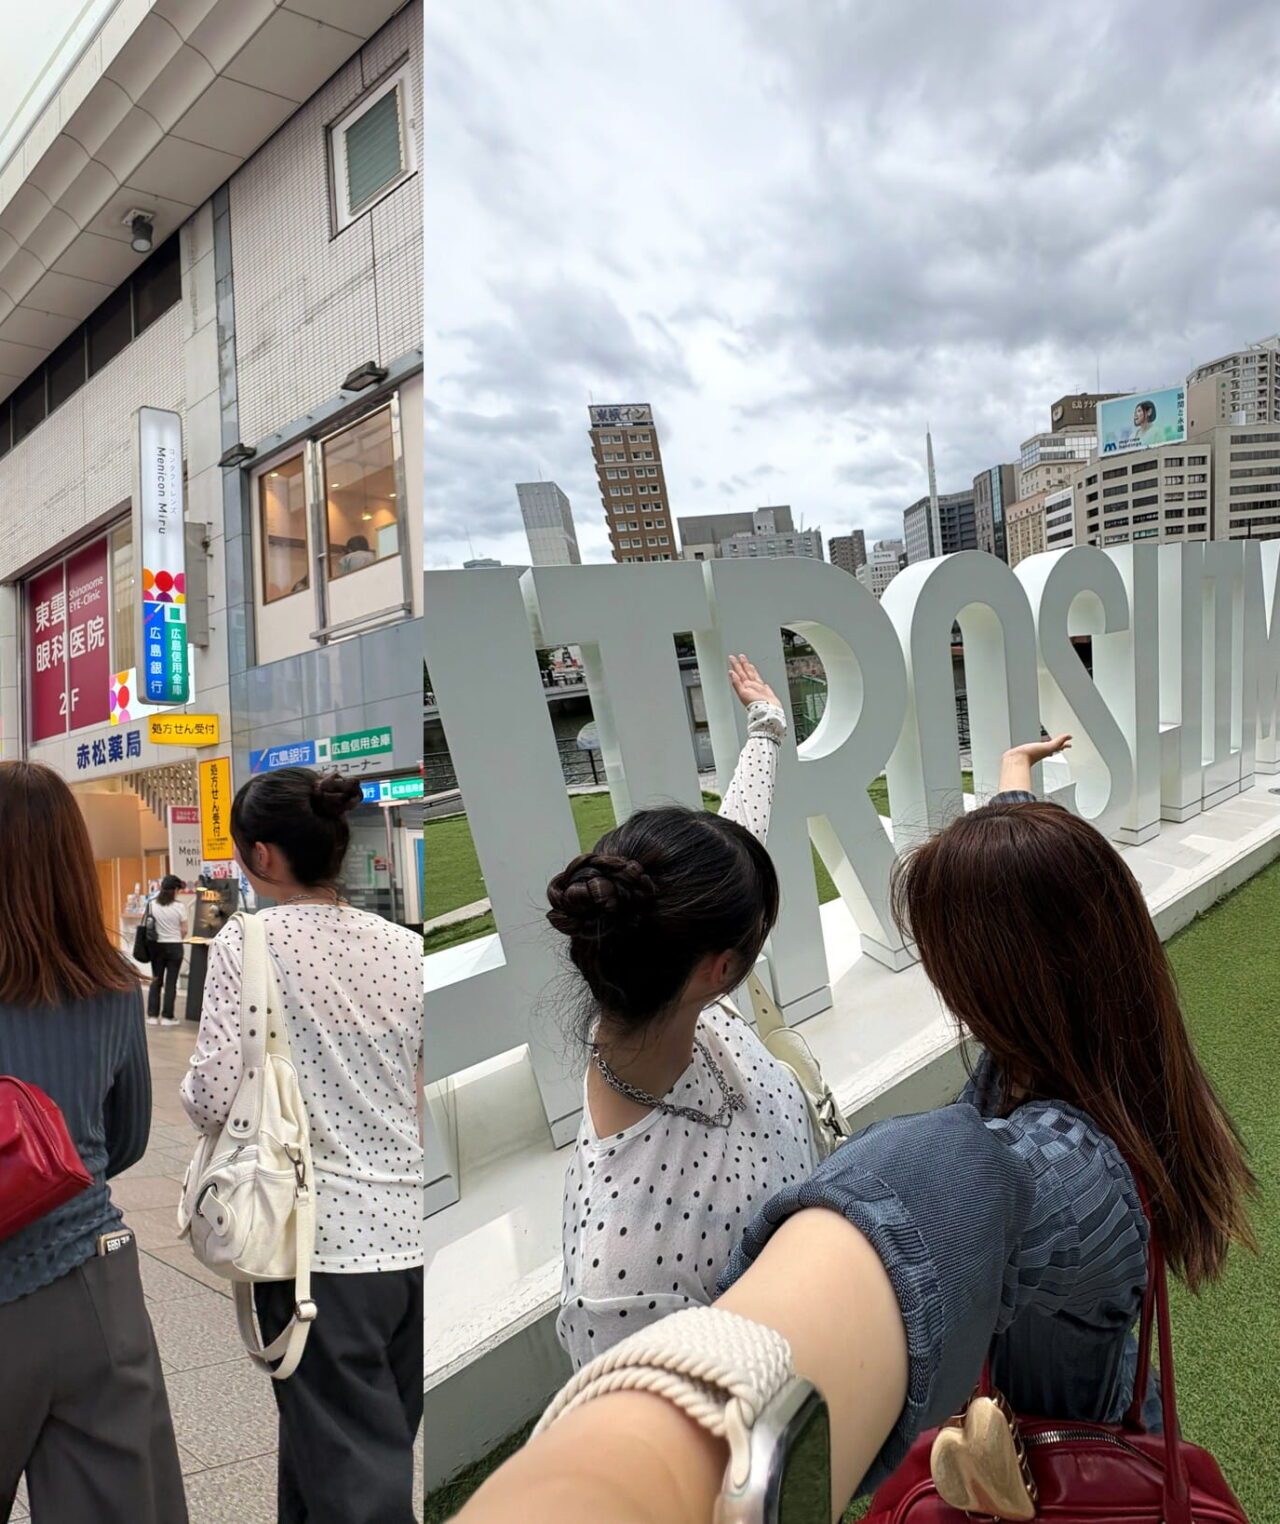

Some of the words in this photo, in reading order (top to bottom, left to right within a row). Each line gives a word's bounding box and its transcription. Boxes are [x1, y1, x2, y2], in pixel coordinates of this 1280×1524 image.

[596, 407, 646, 421] 東横イン
[156, 446, 166, 497] Menicon
[158, 502, 169, 534] Miru
[68, 575, 104, 600] Shinonome
[35, 590, 65, 633] 東雲
[36, 615, 105, 672] 眼科医院
[150, 626, 162, 694] 広島銀行
[171, 627, 183, 695] 広島信用金庫
[58, 688, 80, 716] 2F
[151, 722, 215, 735] 処方せん受付
[331, 733, 391, 755] 広島信用金庫
[76, 729, 142, 770] 赤松薬局
[269, 746, 310, 767] 広島銀行
